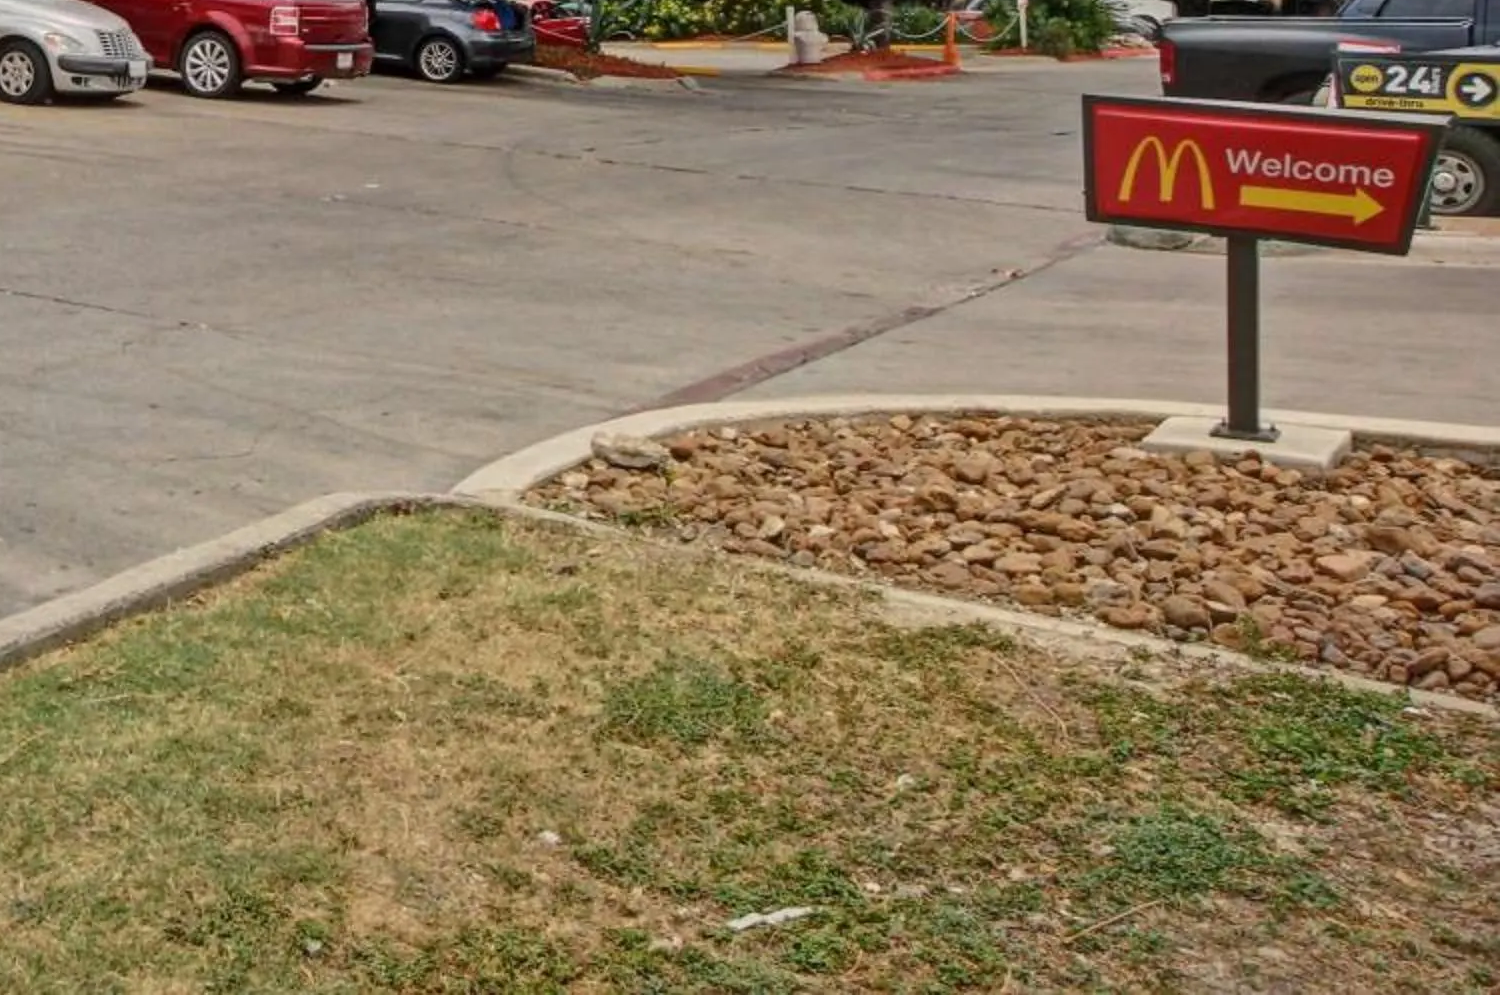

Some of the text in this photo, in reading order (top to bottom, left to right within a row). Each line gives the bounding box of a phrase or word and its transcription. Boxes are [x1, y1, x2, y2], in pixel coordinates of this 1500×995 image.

[1384, 64, 1431, 94] 24
[1365, 97, 1425, 109] drive-thru
[1225, 148, 1395, 188] Welcome
